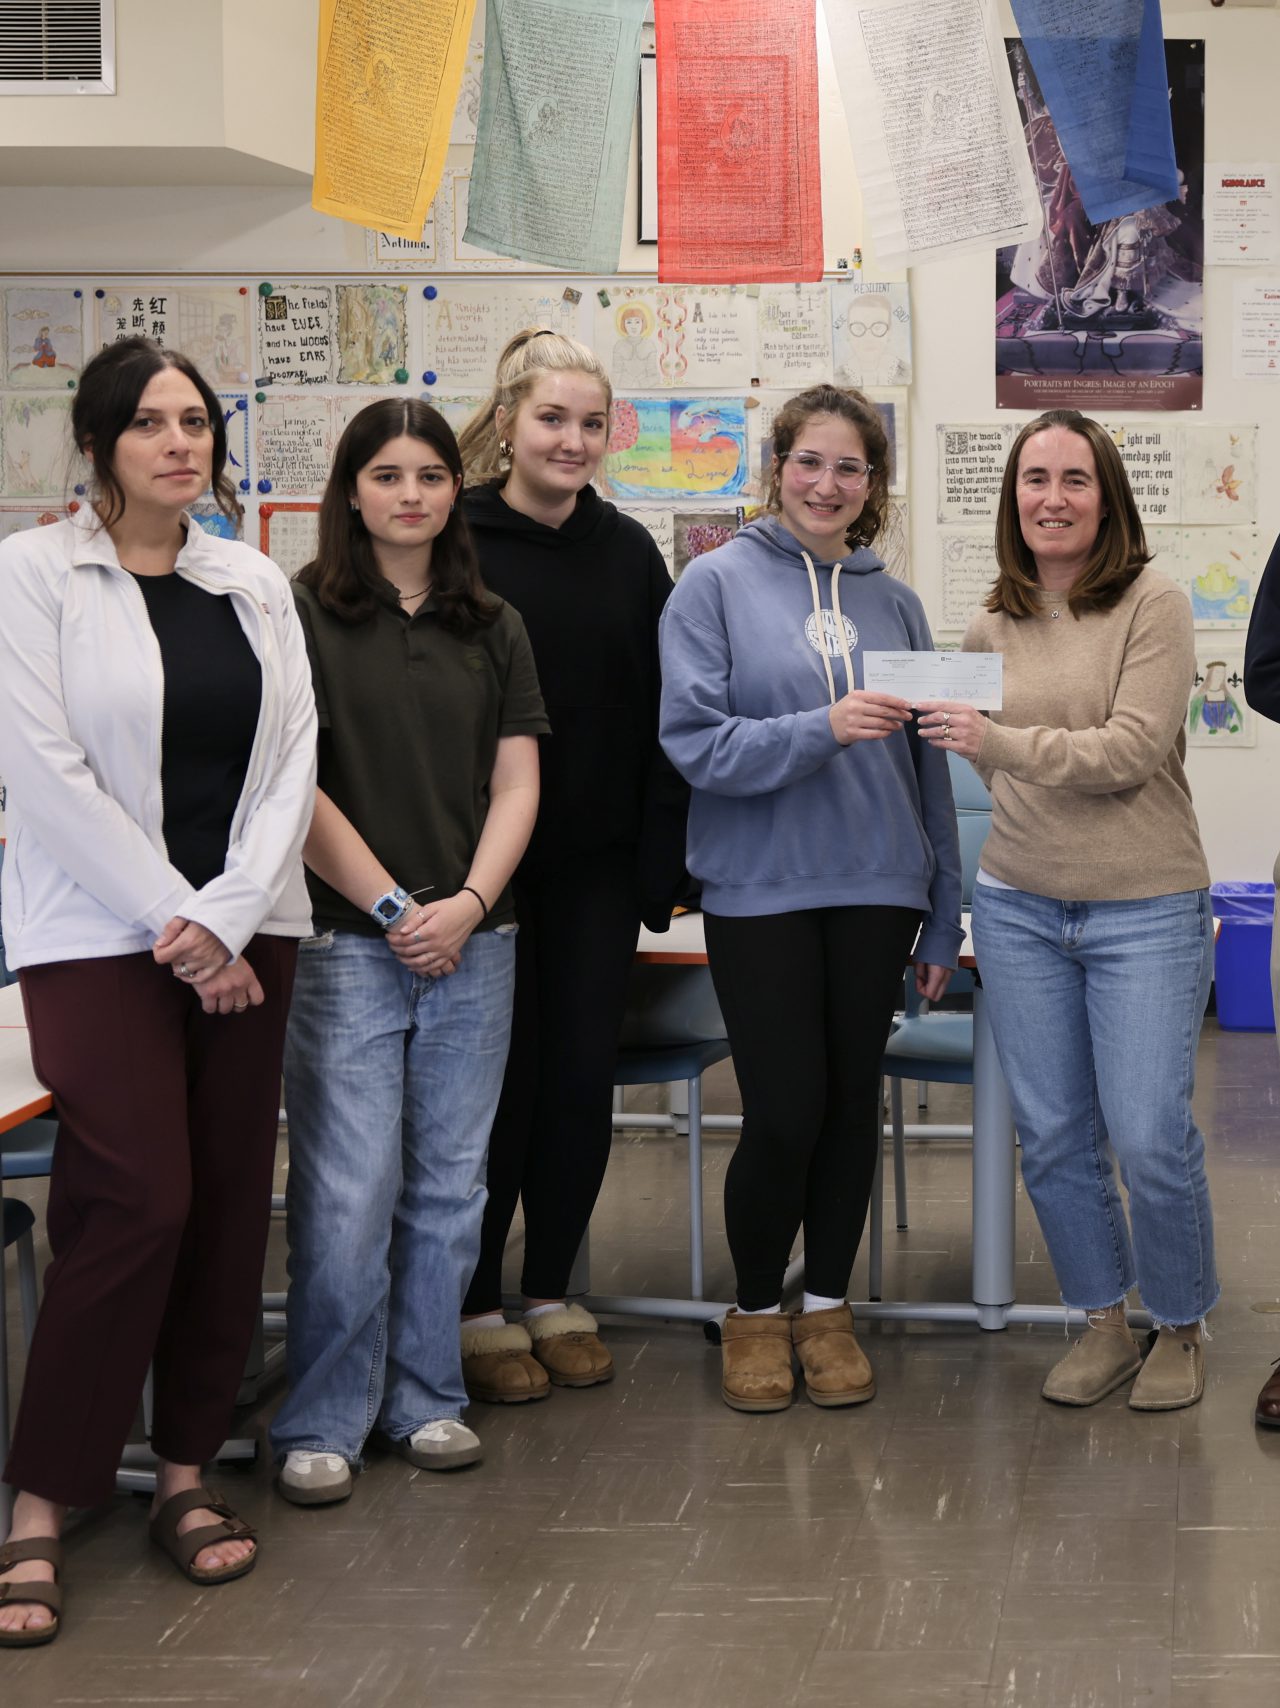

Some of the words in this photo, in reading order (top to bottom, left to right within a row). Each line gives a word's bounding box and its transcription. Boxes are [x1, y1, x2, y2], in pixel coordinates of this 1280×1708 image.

[1024, 380, 1062, 388] PORTRAITS
[1064, 380, 1072, 388] BY
[1103, 380, 1126, 388] IMAGE
[1150, 380, 1175, 388] EPOCH
[980, 432, 1002, 440] world
[1146, 434, 1161, 444] will
[978, 444, 1002, 452] divided
[979, 456, 995, 464] who
[1121, 451, 1150, 464] omeday
[1153, 451, 1171, 464] split
[946, 467, 963, 475] have
[1132, 470, 1153, 481] open;
[1155, 470, 1173, 479] even
[946, 476, 974, 485] religion
[947, 486, 962, 494] who
[964, 486, 979, 494] have
[980, 486, 1002, 494] religio
[1132, 486, 1144, 496] our
[1147, 484, 1159, 495] life
[1162, 484, 1169, 496] is
[1150, 504, 1167, 514] cage
